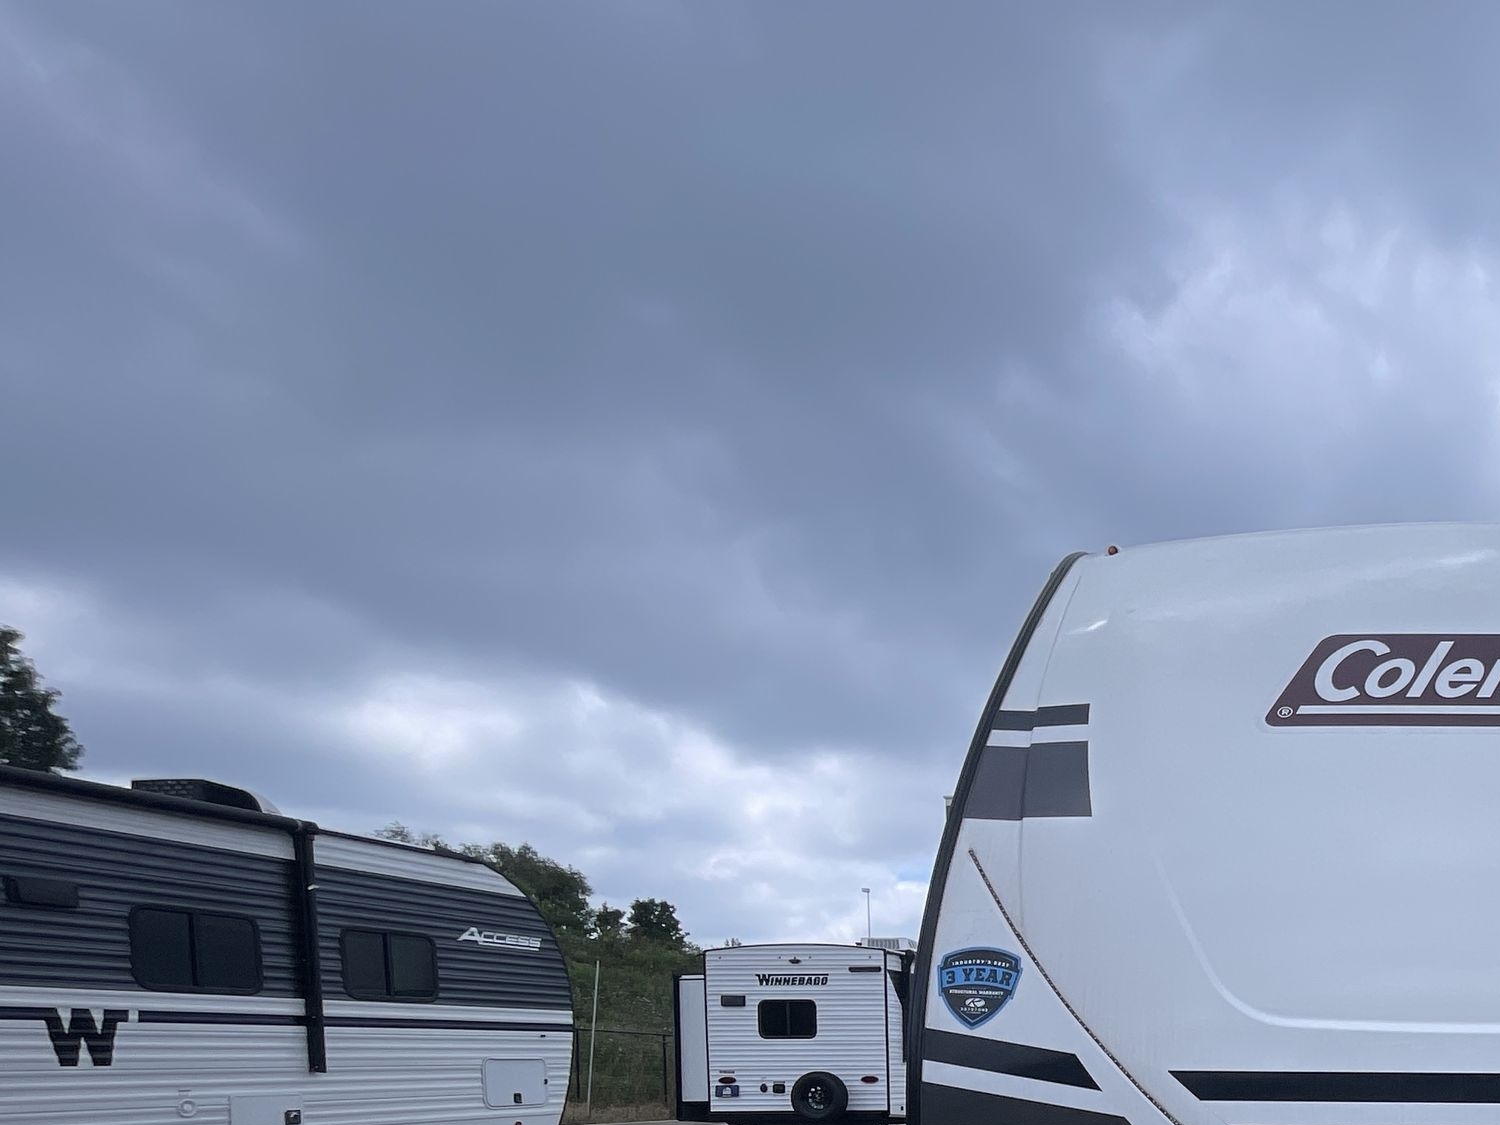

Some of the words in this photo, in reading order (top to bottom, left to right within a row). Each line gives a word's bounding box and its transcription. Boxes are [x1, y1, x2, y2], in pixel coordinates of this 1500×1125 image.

[457, 927, 542, 949] ACCESS
[755, 973, 829, 986] WINNEBAGO
[946, 970, 956, 985] 3
[962, 967, 1013, 987] YEAR
